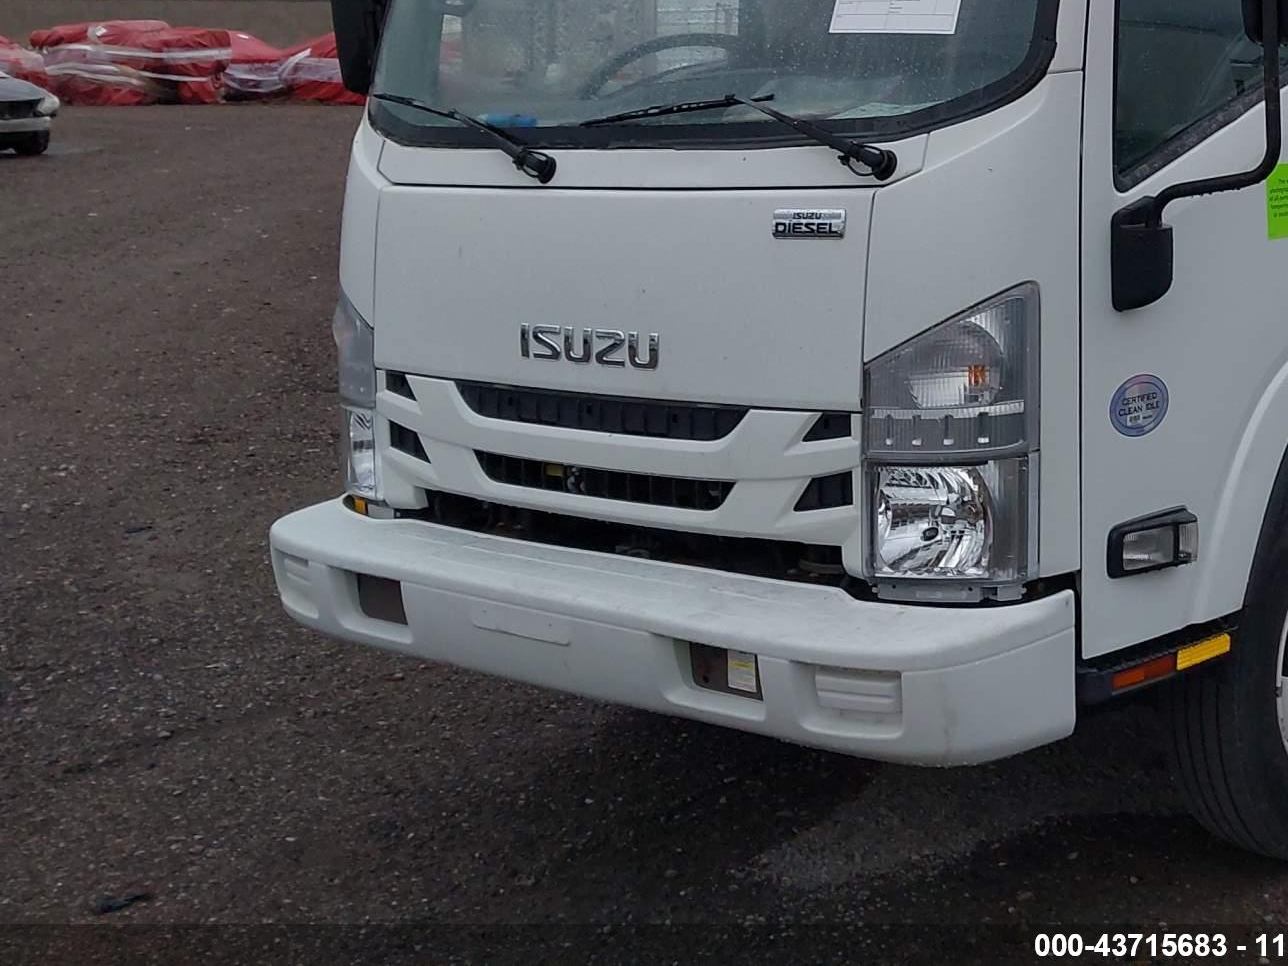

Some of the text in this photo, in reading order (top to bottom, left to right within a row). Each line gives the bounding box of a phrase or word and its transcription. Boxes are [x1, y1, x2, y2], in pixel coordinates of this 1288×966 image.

[792, 212, 823, 220] ISUZU
[774, 221, 839, 234] DIESEL
[519, 322, 660, 371] ISUZU
[1122, 392, 1157, 405] CERTIFIED
[1119, 401, 1160, 416] CLEAN IDLE
